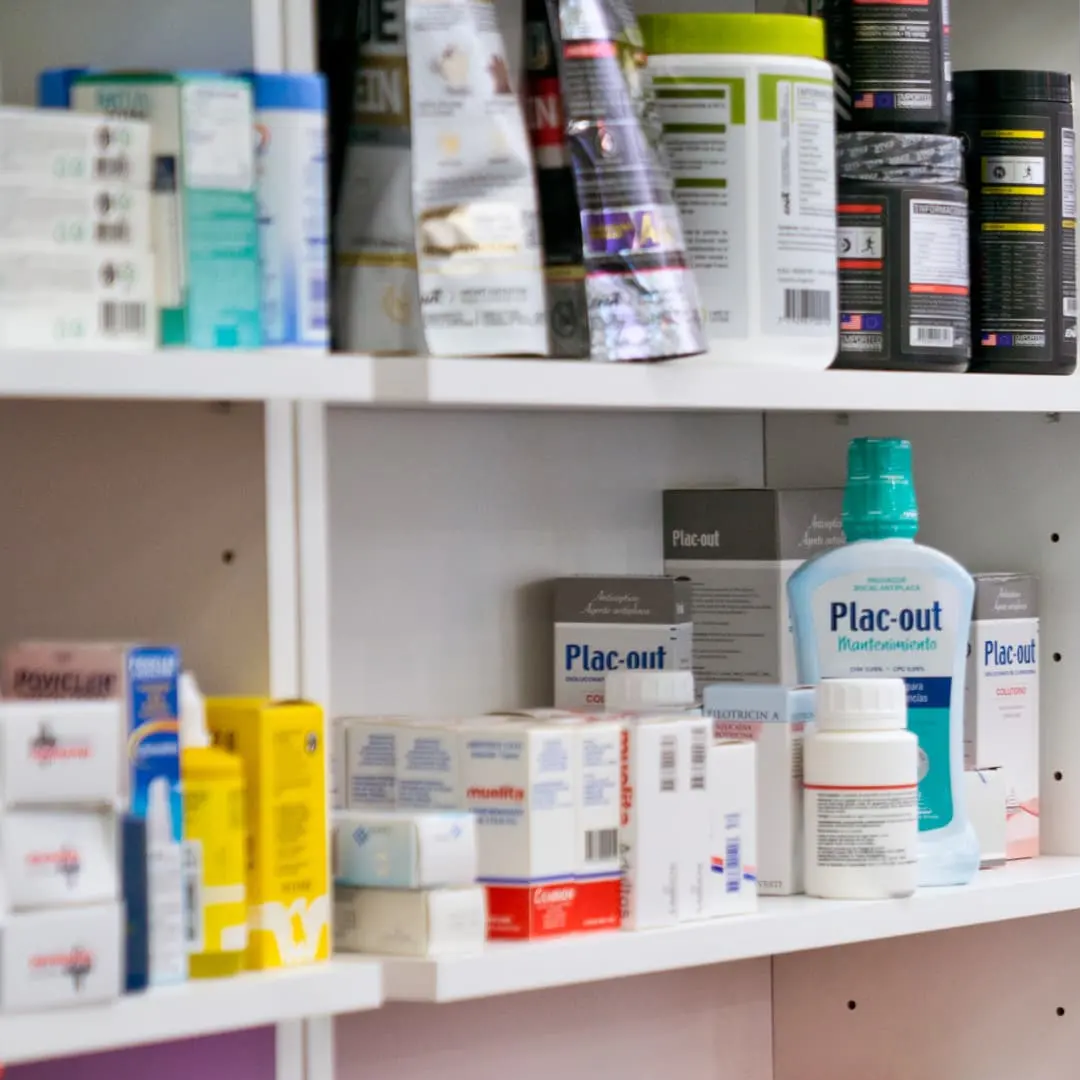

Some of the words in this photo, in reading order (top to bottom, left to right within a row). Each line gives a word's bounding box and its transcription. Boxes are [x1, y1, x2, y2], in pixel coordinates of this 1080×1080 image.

[672, 530, 720, 547] Plac-out
[830, 601, 943, 632] Plac-out
[565, 644, 667, 672] Plac-out
[837, 635, 937, 653] Mantenimiento
[984, 638, 1036, 667] Plac-out
